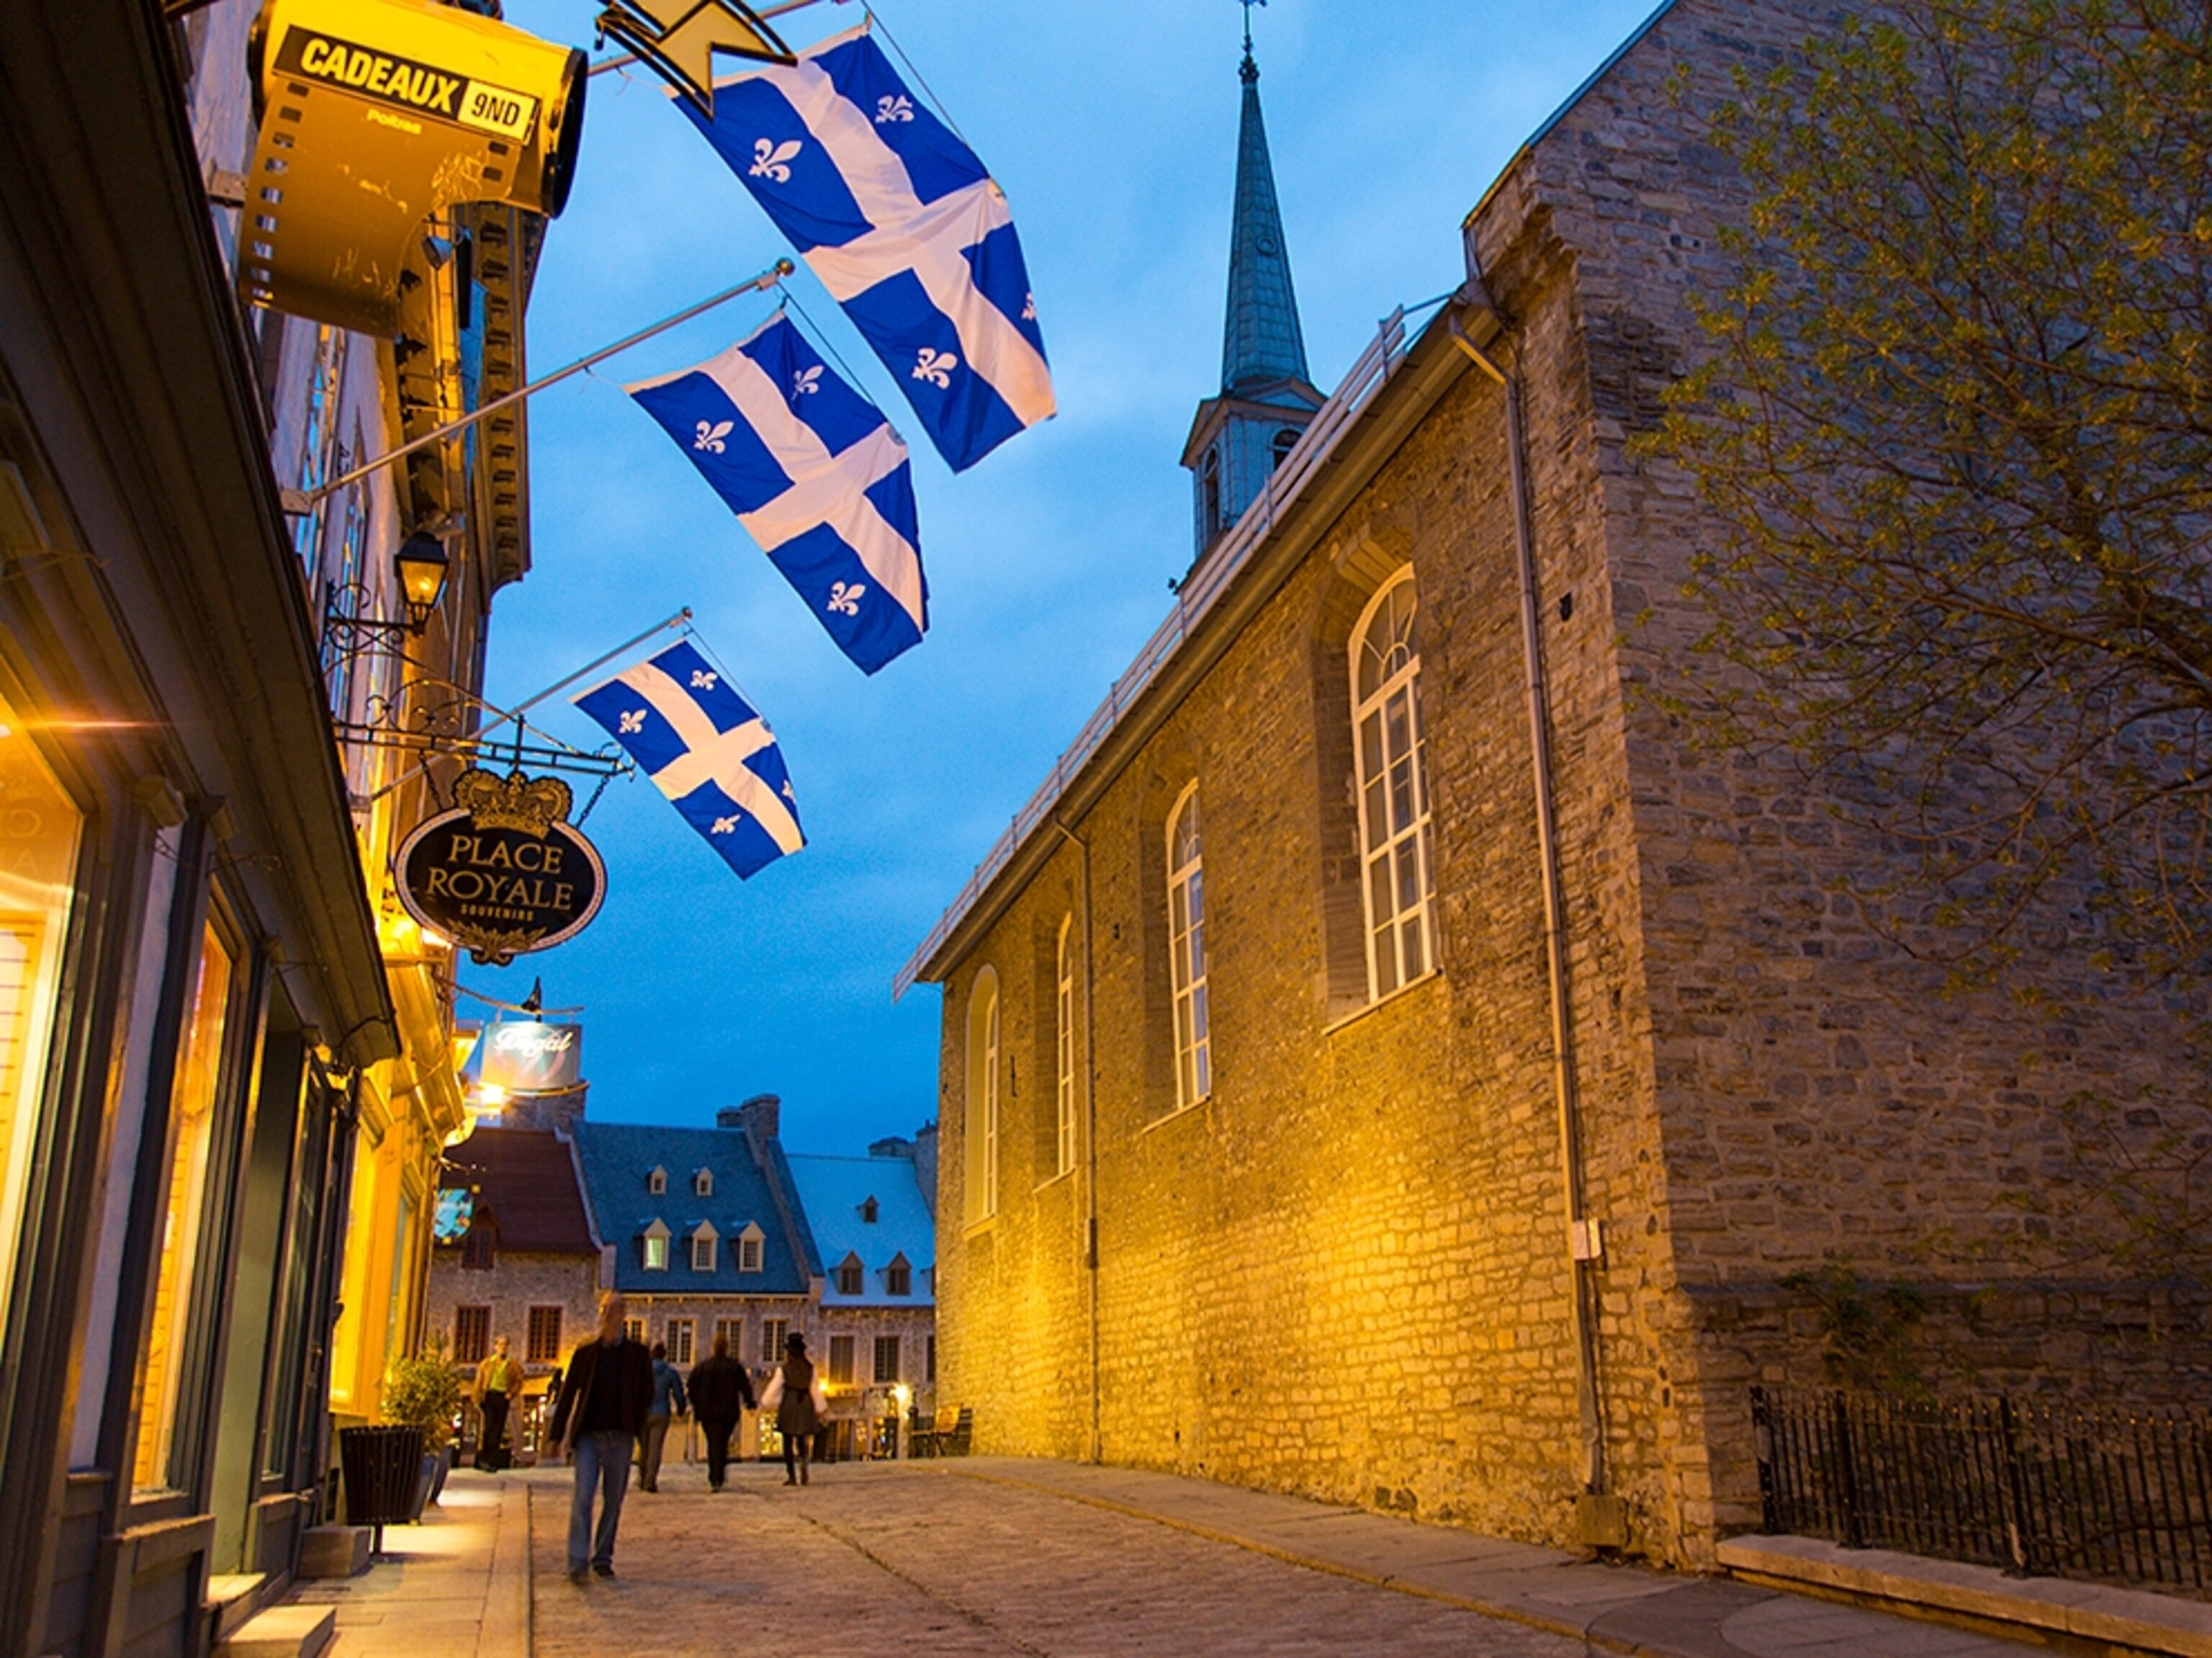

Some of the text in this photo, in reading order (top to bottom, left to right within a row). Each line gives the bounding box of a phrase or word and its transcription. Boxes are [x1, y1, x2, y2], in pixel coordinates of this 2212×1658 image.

[301, 38, 521, 127] CADEAUX 9ND
[448, 833, 564, 875] PLACE
[426, 866, 574, 910] ROYALE
